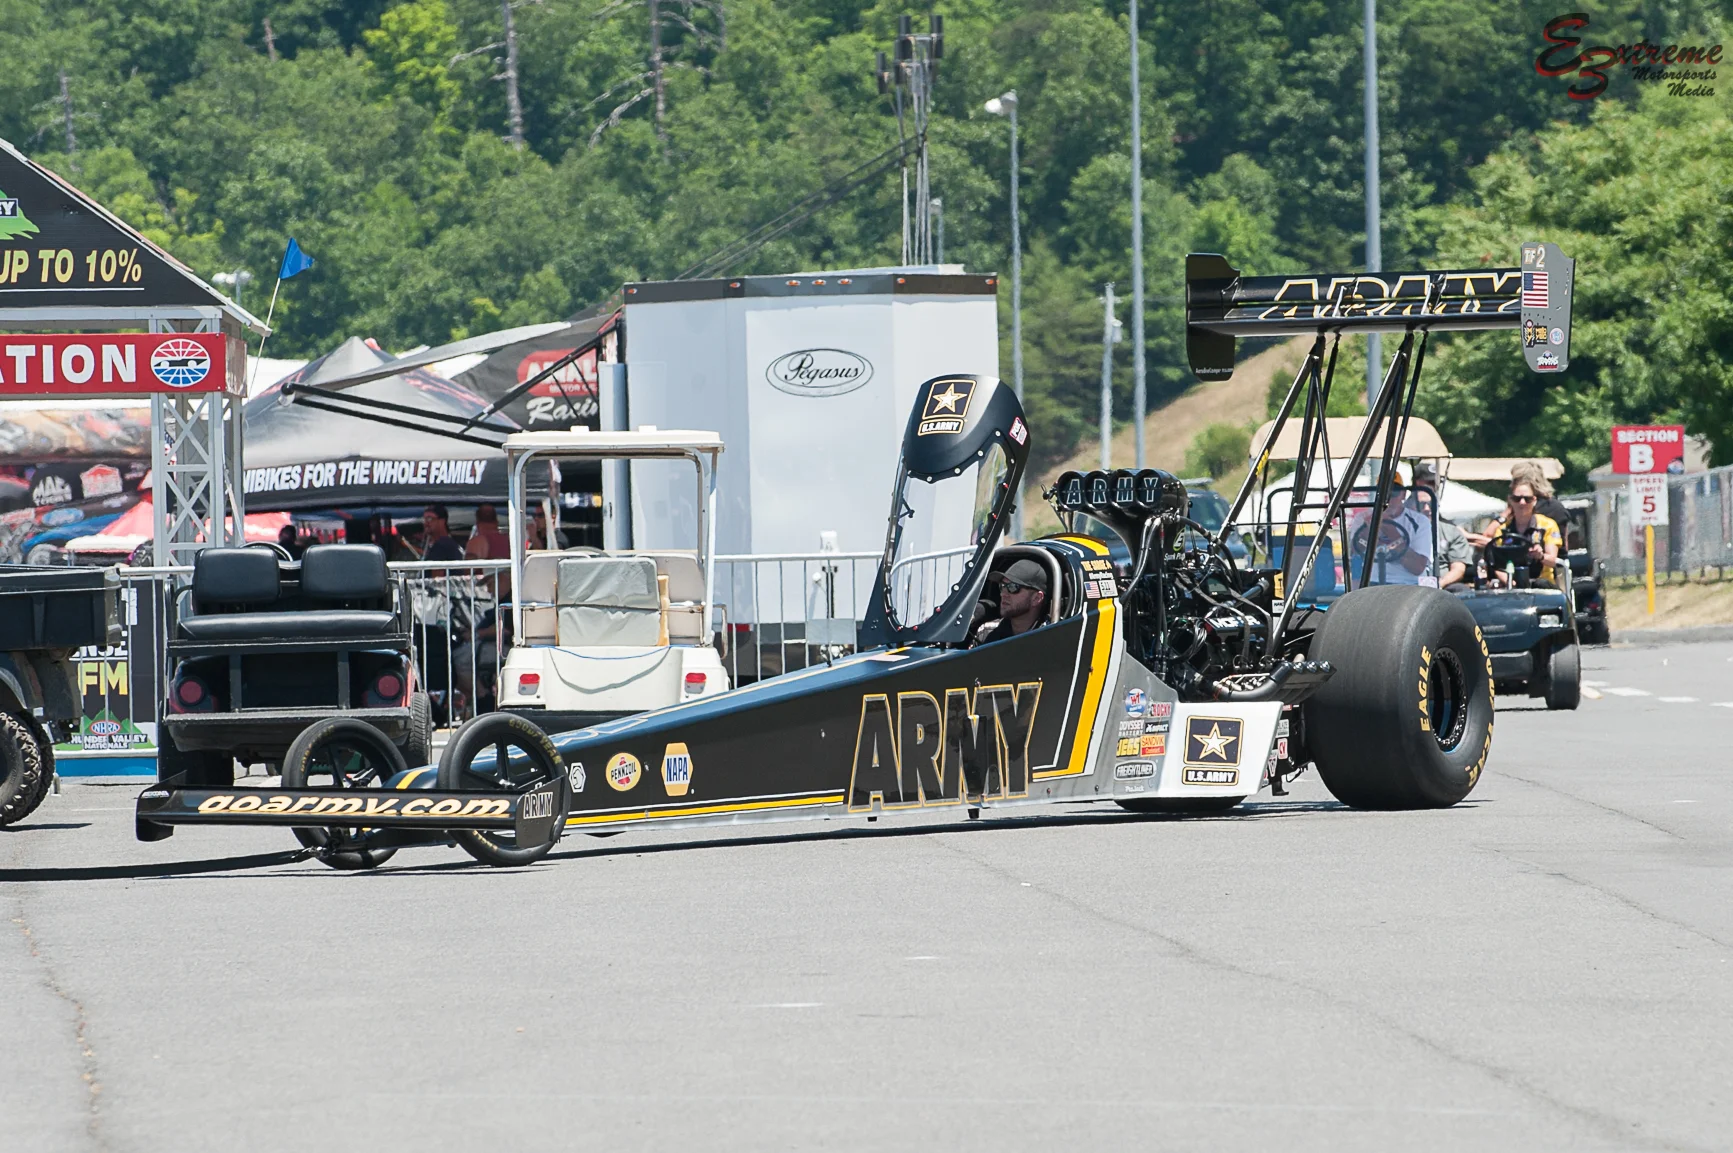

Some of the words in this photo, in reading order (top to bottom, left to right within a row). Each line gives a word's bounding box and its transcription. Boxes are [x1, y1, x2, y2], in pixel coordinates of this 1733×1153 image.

[38, 248, 74, 283] TO
[86, 248, 142, 283] 10%
[1536, 244, 1546, 268] 2
[0, 344, 136, 384] TION
[784, 353, 859, 385] Pegasus
[1617, 430, 1679, 443] SECTION
[1629, 444, 1655, 472] B
[302, 462, 336, 488] FOR
[338, 460, 372, 485] THE
[373, 460, 429, 484] WHOLE
[429, 459, 487, 485] FAMILY
[1066, 476, 1159, 504] ARMY
[1642, 495, 1656, 513] 5
[77, 662, 128, 695] FM
[1418, 645, 1432, 731] EAGLE
[93, 722, 120, 733] NHRA
[112, 734, 147, 743] VALLEY
[1119, 720, 1144, 731] ODYSSEY
[848, 682, 1043, 813] ARMY
[1116, 738, 1141, 756] JEGS
[610, 762, 637, 781] PENNZOIL
[666, 756, 688, 782] NAPA
[197, 794, 511, 818] goarmy.com
[523, 791, 554, 820] ARMY
